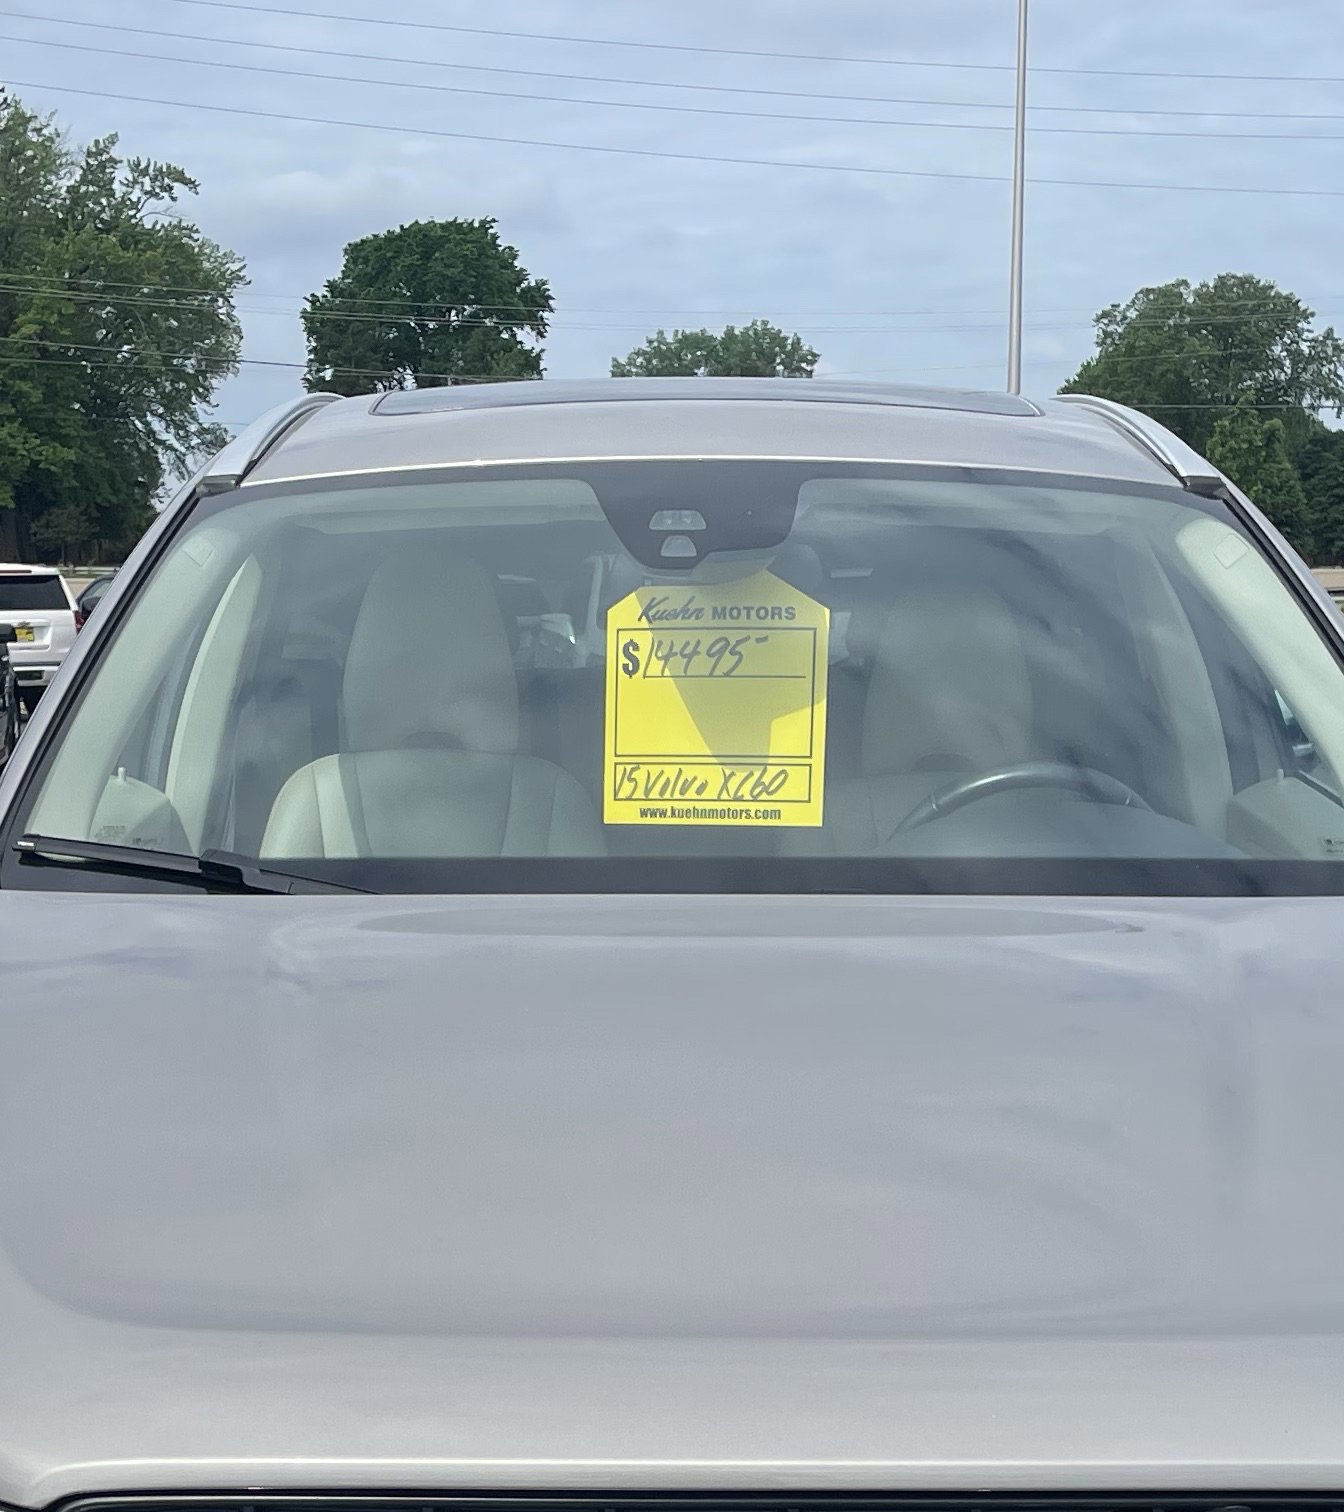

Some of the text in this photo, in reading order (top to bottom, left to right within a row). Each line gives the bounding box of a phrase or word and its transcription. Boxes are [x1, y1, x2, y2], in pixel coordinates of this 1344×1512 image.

[637, 595, 796, 624] Kuehn MOTORS
[643, 768, 708, 799] Volvo
[639, 806, 781, 820] www.kuehnmotors.com
